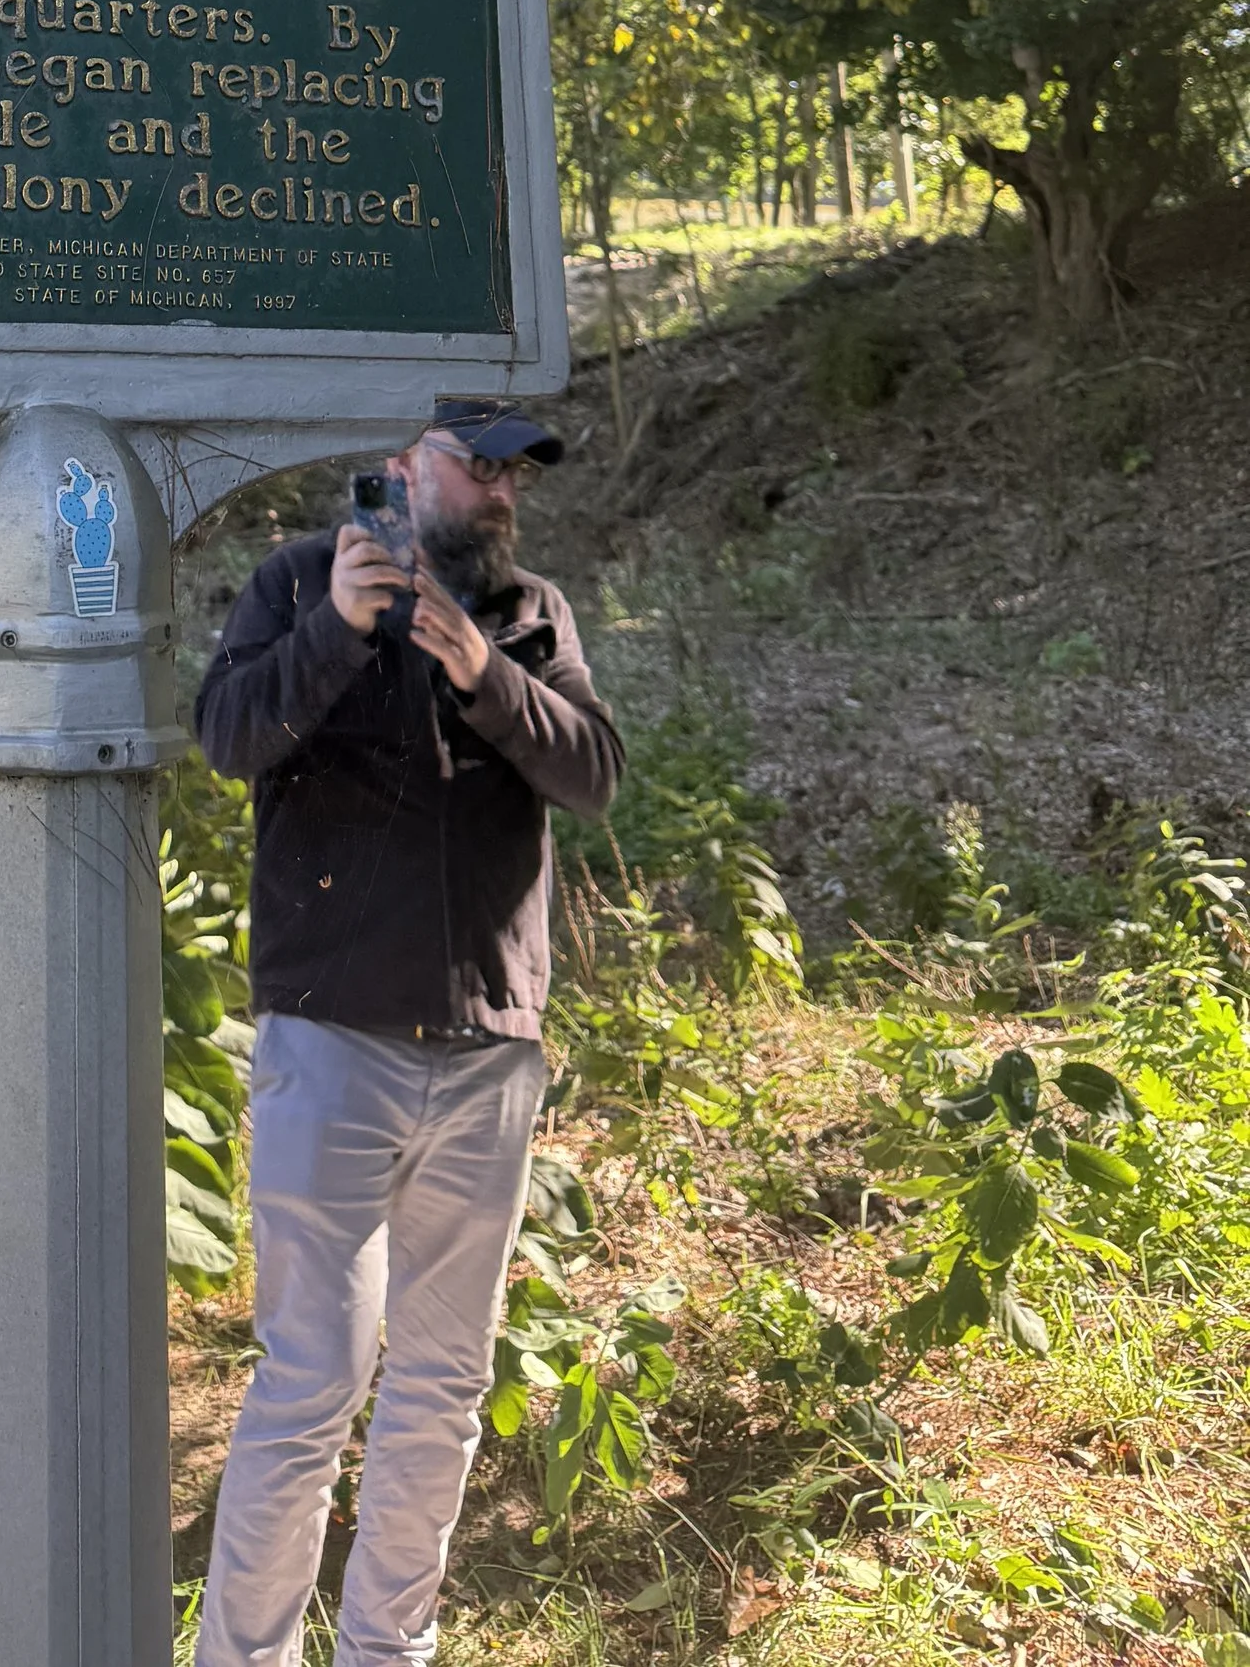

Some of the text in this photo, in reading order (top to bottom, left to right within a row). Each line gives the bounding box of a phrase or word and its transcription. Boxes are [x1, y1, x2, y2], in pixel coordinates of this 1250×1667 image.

[327, 4, 400, 66] By
[191, 58, 445, 123] replacing
[108, 112, 212, 157] and
[257, 116, 350, 163] the
[178, 172, 440, 228] declined.
[18, 263, 82, 280] STATE
[96, 266, 141, 281] SITE
[157, 268, 191, 283] NO.
[202, 270, 237, 284] 657
[49, 240, 143, 258] MICHIGAN
[156, 244, 286, 264] DEPARTMENT
[298, 250, 318, 265] OF
[331, 251, 394, 267] STATE
[14, 287, 81, 304] STATE
[95, 290, 120, 306] OF
[131, 291, 234, 310] MICHIGAN,
[254, 294, 296, 310] 1997
